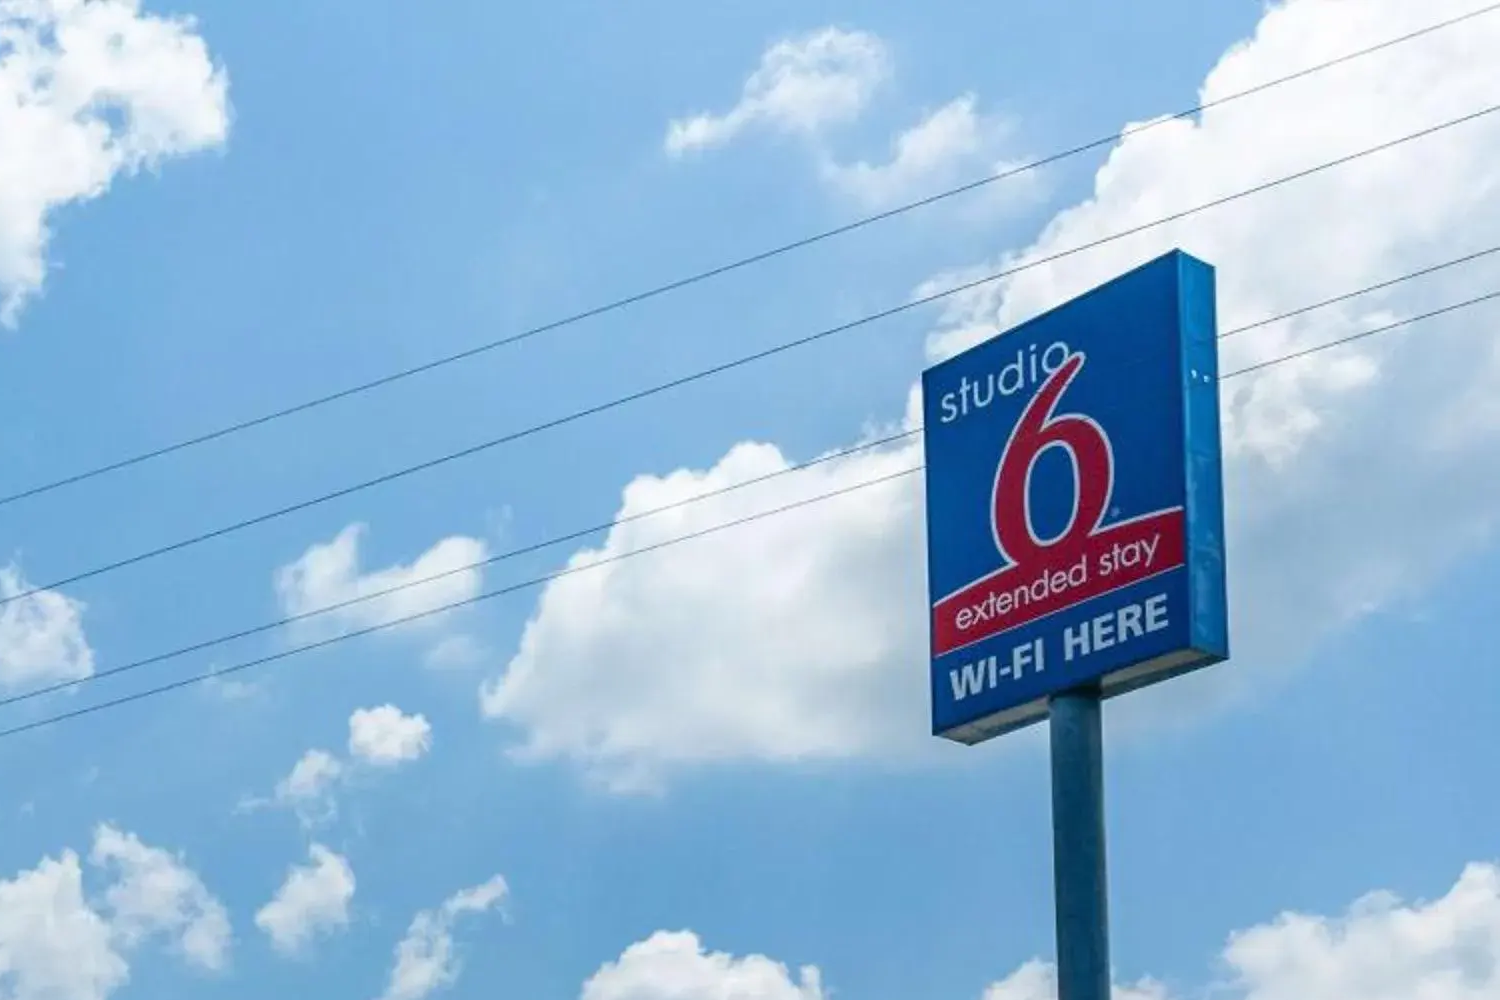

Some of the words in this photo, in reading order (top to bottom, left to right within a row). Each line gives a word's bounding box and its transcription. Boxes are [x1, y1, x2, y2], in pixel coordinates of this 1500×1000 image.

[940, 341, 1069, 423] studio
[990, 351, 1115, 565] 6
[955, 554, 1087, 630] extended
[1100, 534, 1161, 576] stay
[949, 637, 1045, 701] WI-FI
[1063, 592, 1169, 661] HERE
